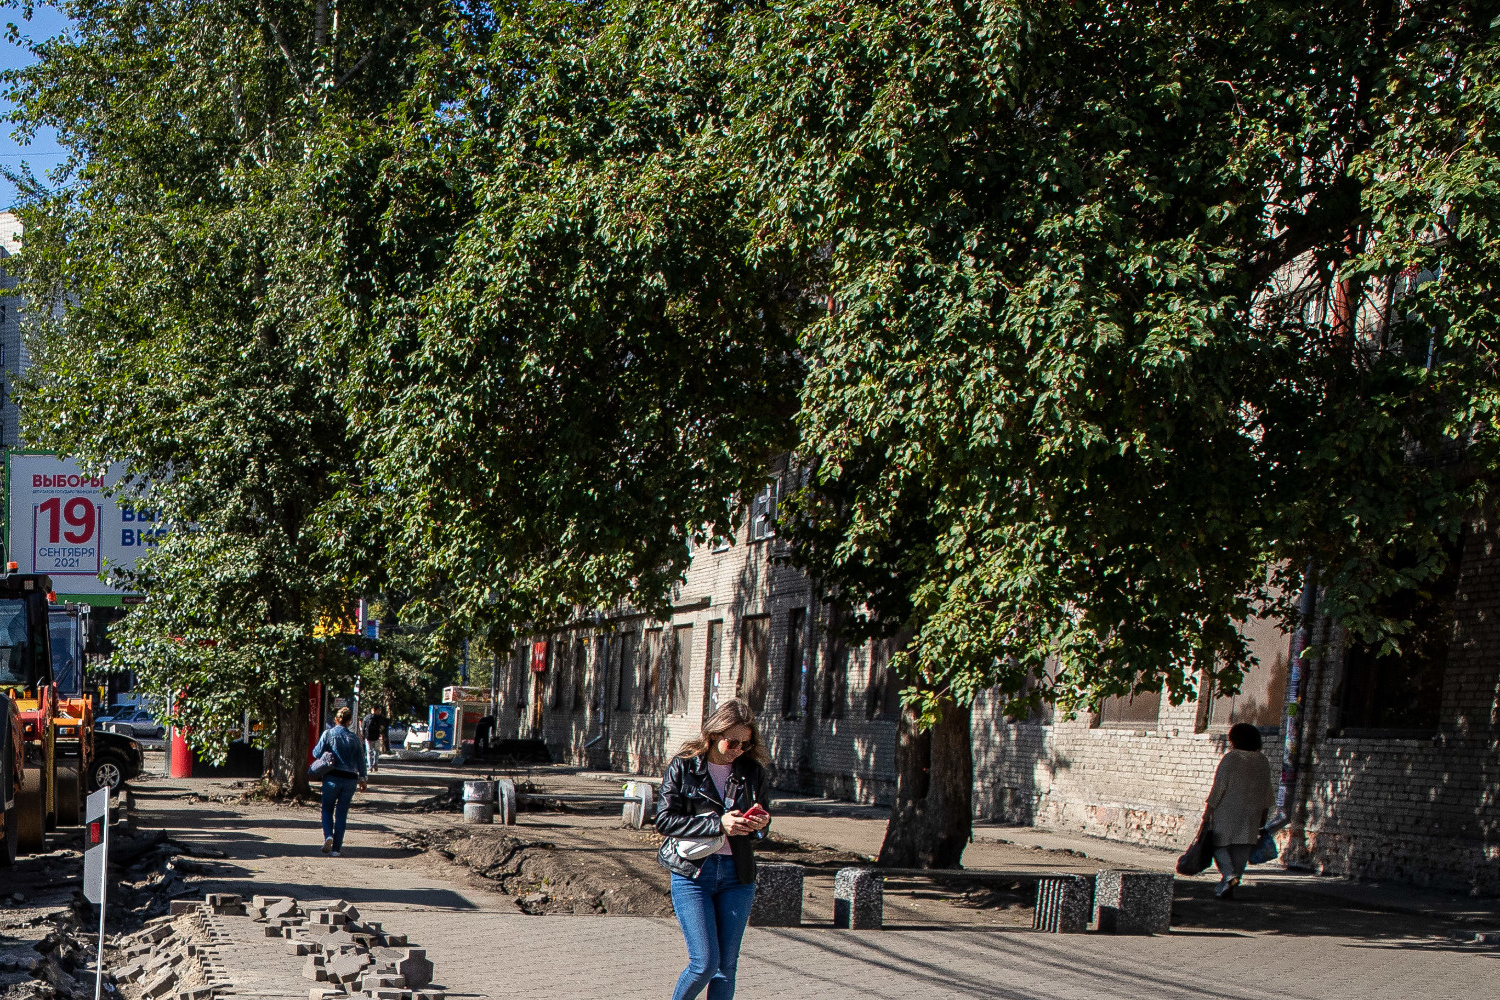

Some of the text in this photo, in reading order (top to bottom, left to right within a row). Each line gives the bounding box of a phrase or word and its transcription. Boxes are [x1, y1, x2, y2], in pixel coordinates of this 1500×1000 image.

[32, 474, 104, 488] ВЫБОРЫ
[39, 496, 96, 544] 19
[39, 547, 95, 558] СЕНТЯБРЯ
[54, 558, 79, 568] 2021
